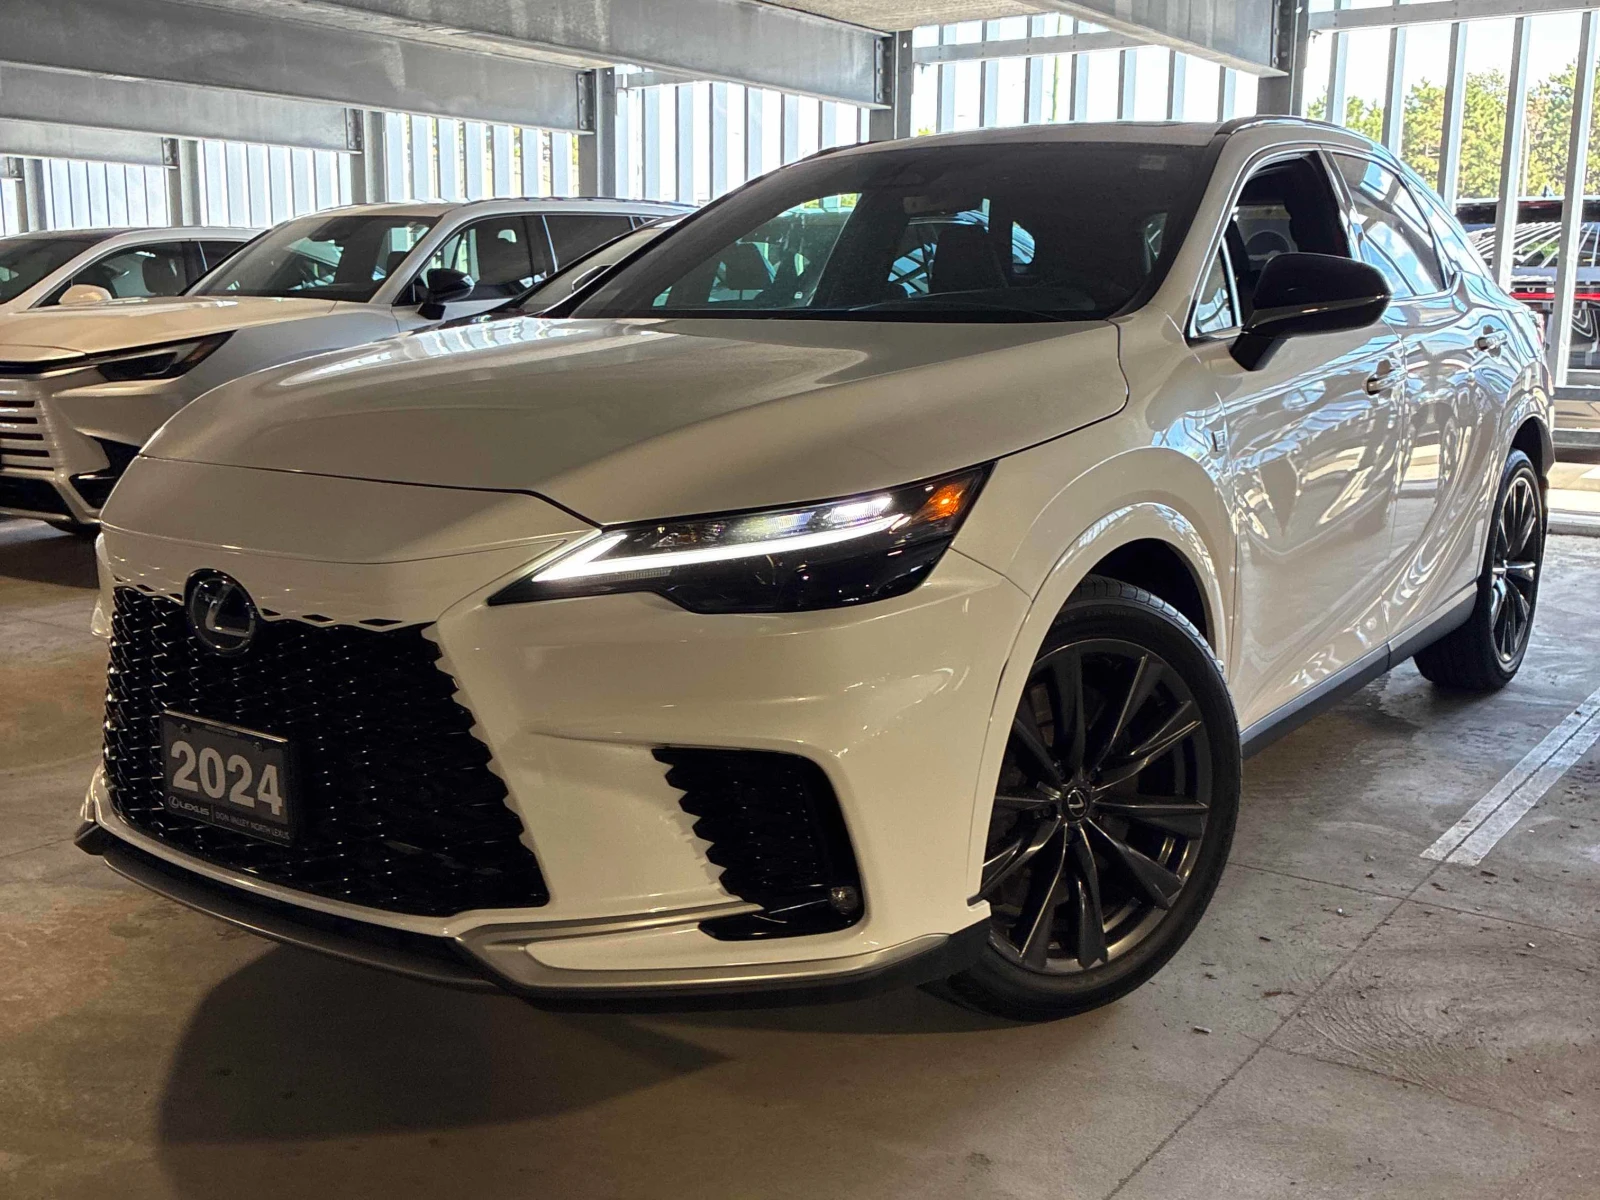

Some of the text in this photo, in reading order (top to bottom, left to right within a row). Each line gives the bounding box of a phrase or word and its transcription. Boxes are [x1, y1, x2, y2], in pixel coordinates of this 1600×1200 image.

[171, 740, 283, 816] 2024
[179, 801, 210, 816] LEXUS
[215, 811, 230, 822] DON
